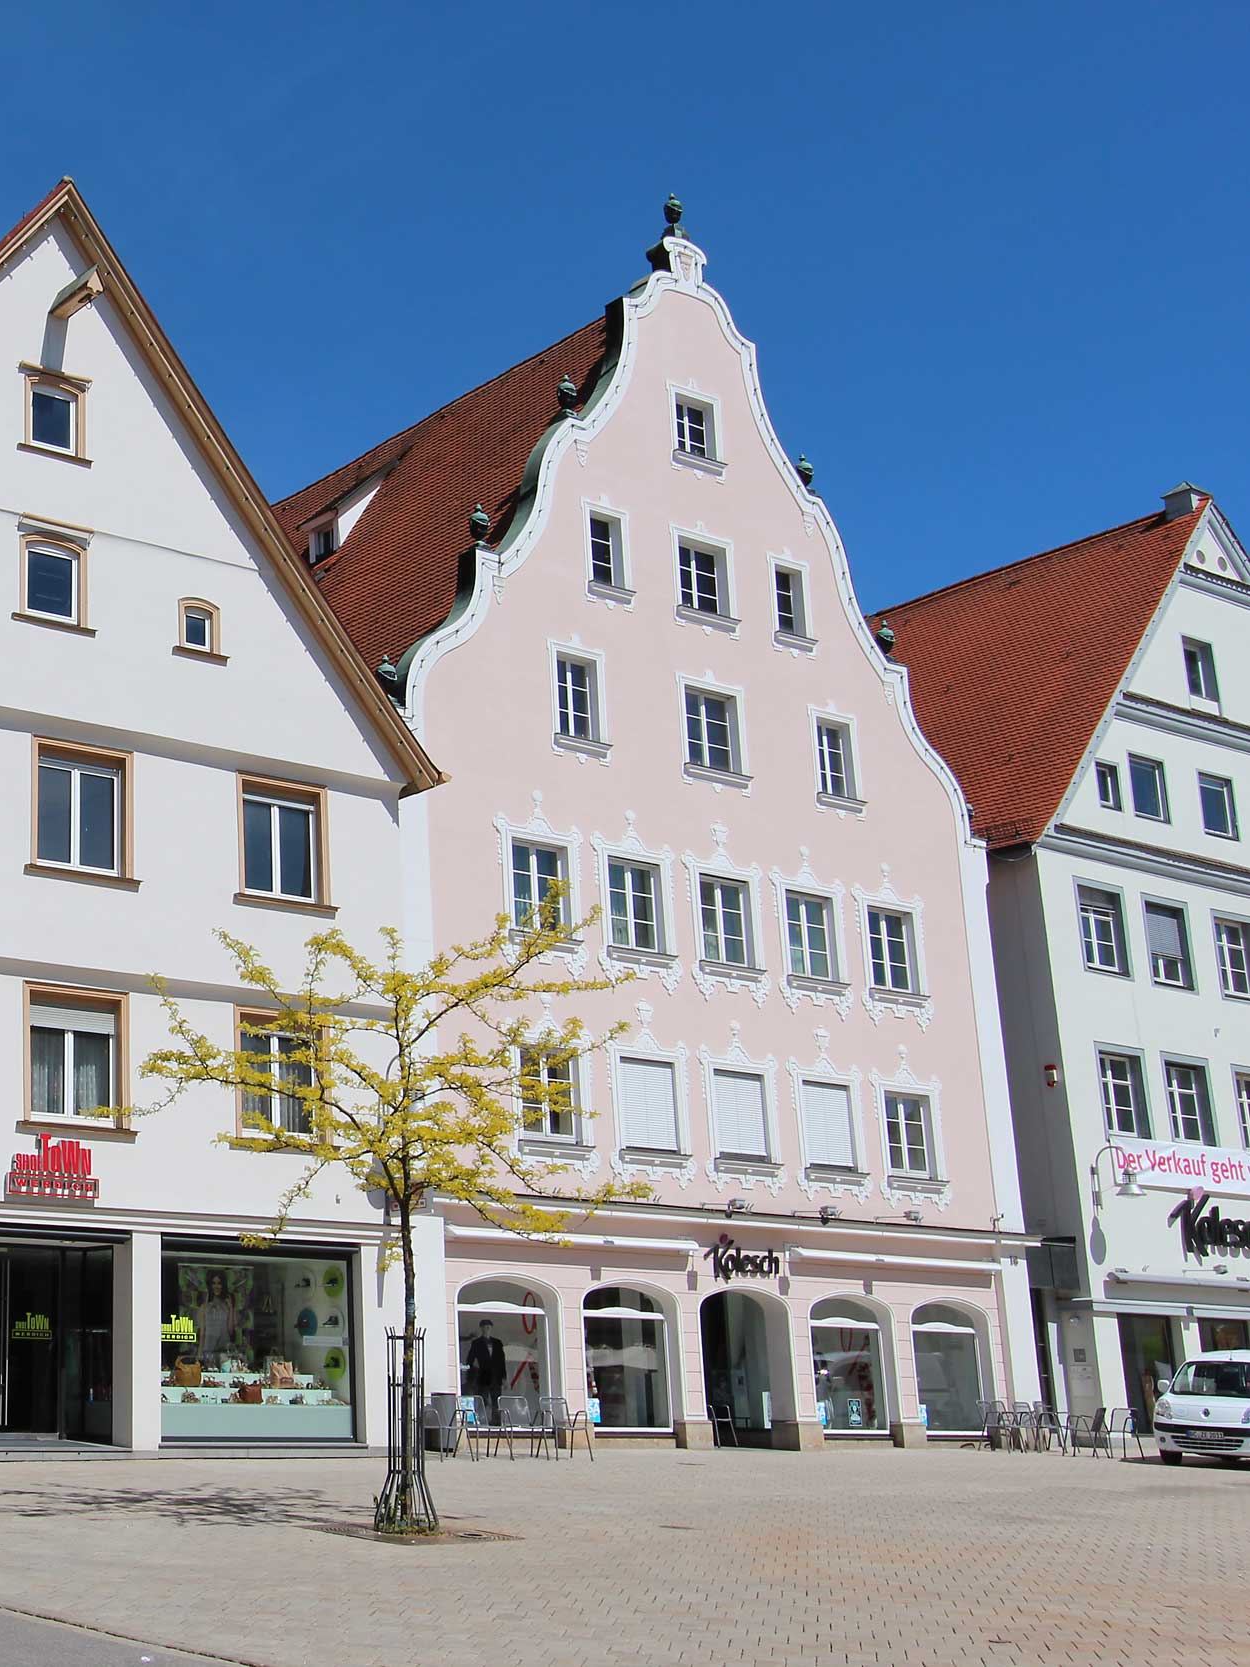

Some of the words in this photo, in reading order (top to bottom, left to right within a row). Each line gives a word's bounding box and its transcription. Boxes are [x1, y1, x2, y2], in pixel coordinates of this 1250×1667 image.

[15, 1178, 93, 1191] WERDICH
[1115, 1147, 1143, 1171] Der
[1145, 1149, 1207, 1177] Verkauf
[1211, 1157, 1247, 1184] geht
[1168, 1193, 1250, 1257] Koles
[704, 1239, 780, 1280] Kolesch
